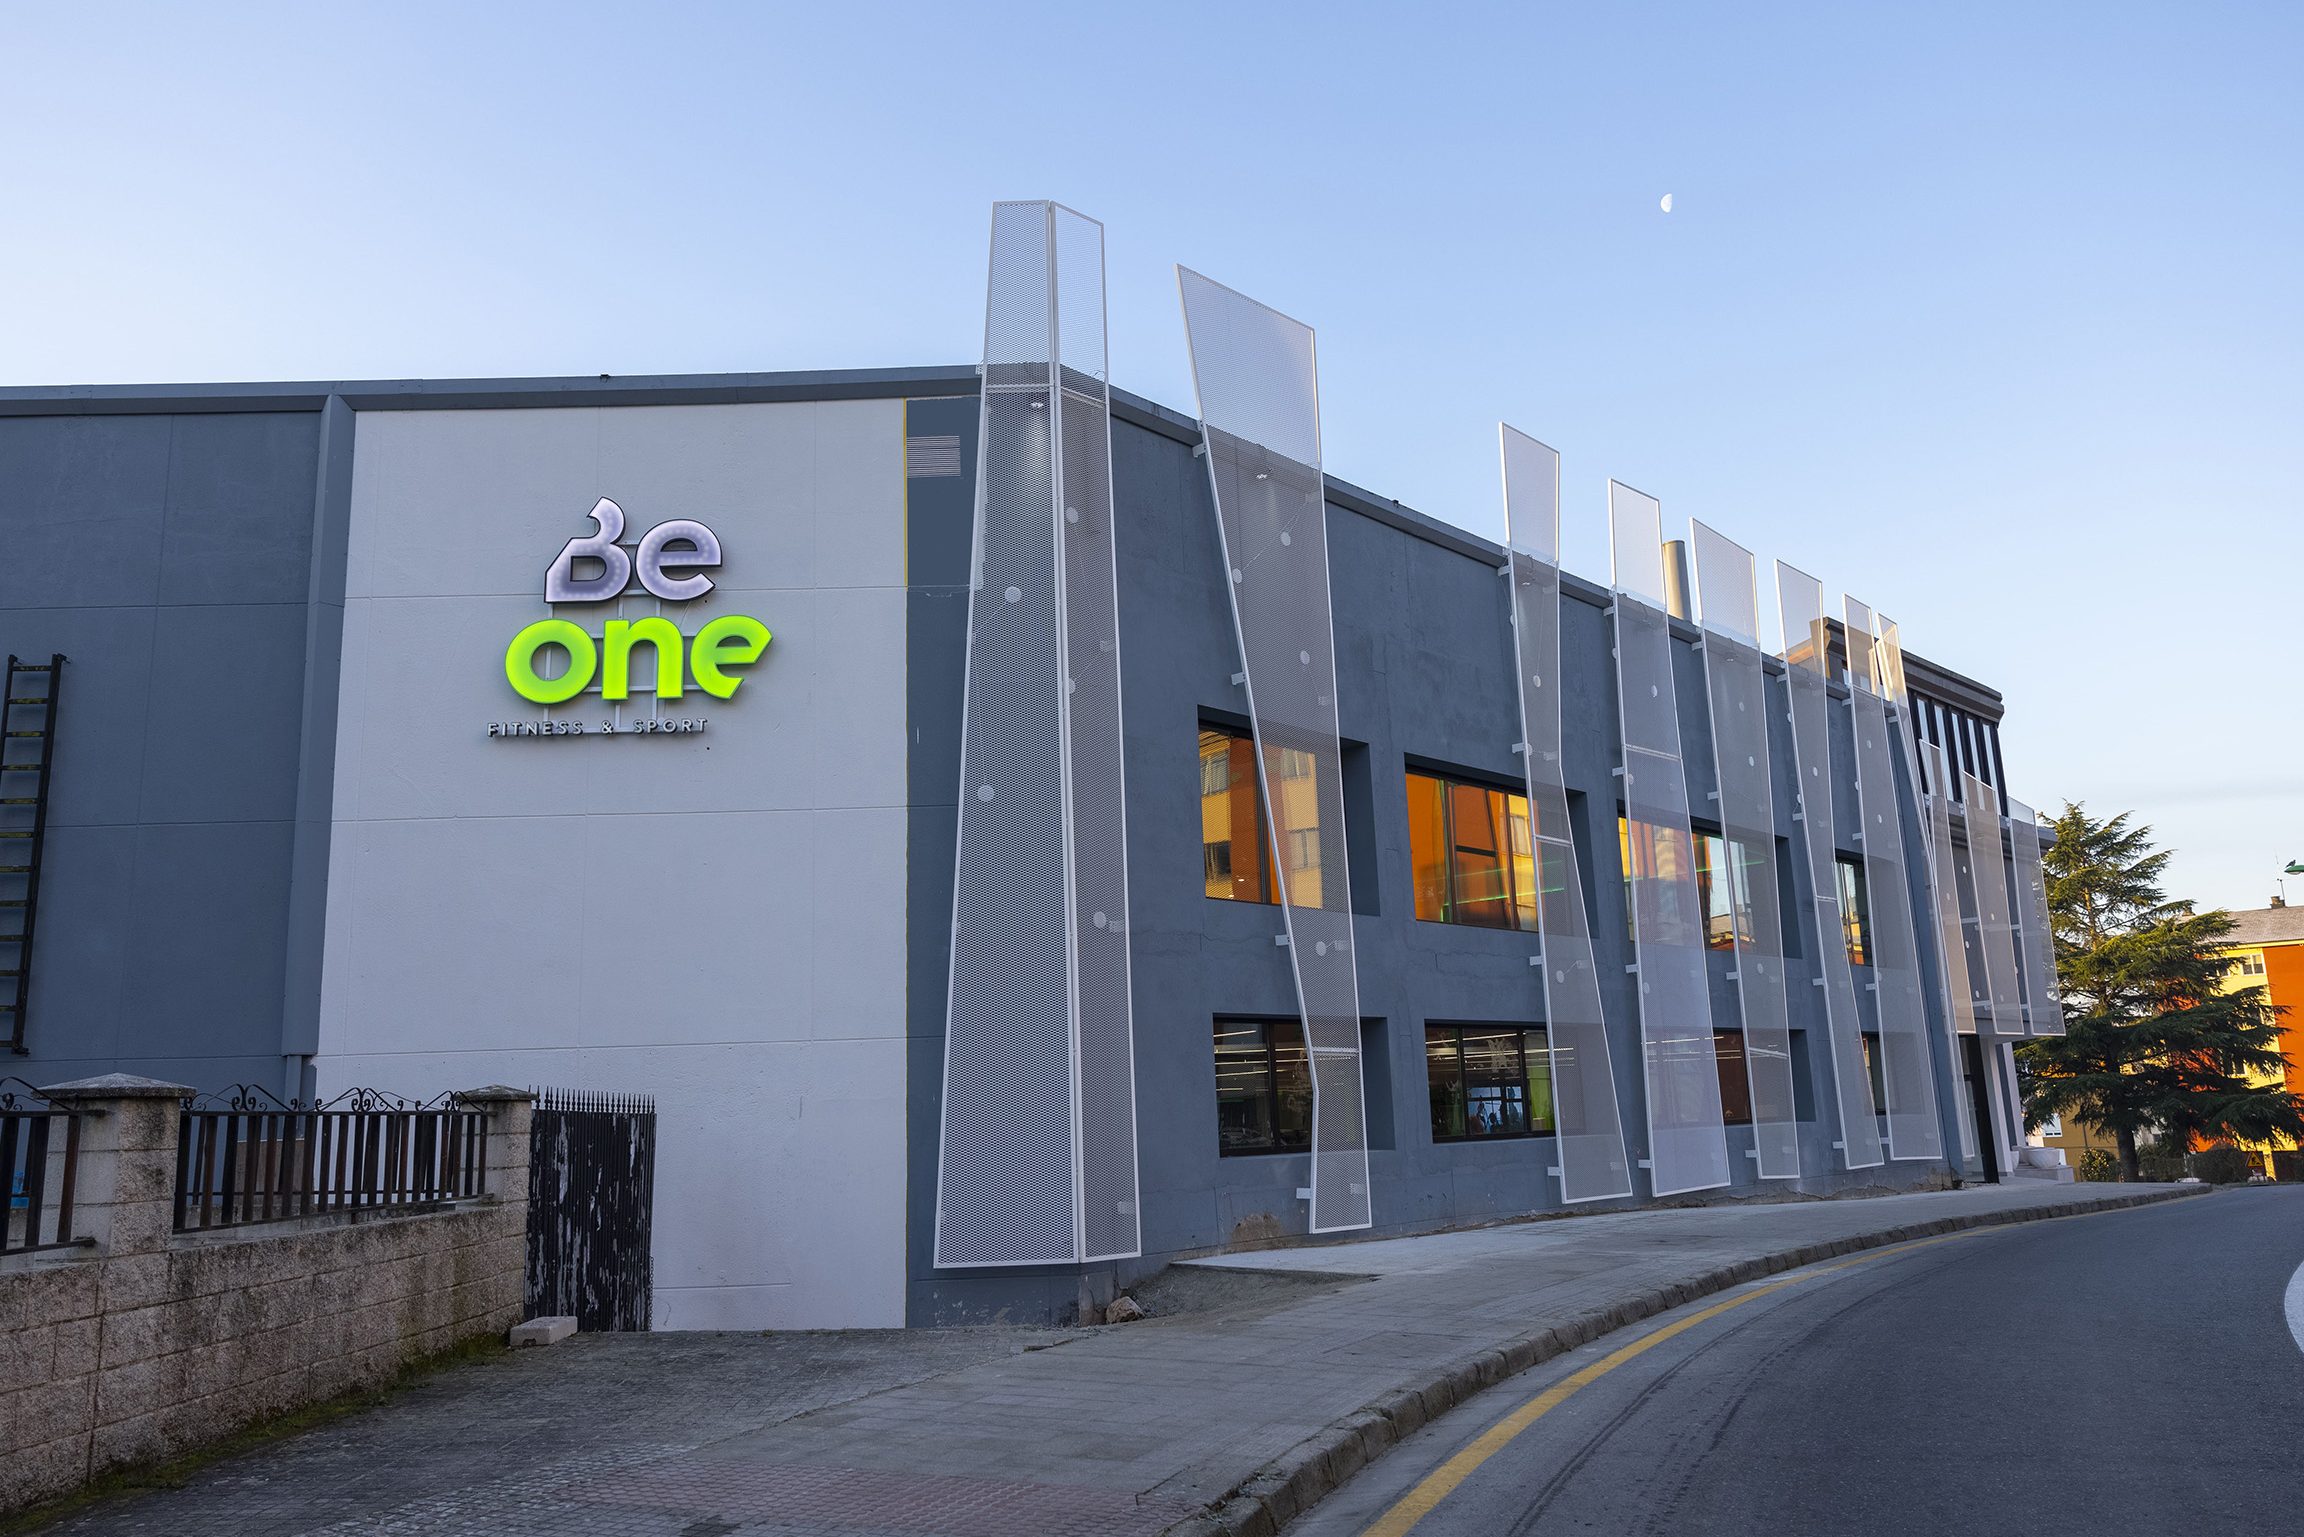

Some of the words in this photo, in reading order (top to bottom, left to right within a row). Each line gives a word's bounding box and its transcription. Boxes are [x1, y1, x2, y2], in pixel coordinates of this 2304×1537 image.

[544, 496, 722, 602] Be
[505, 615, 773, 704] one
[487, 720, 583, 737] FITNESS
[601, 720, 614, 734] &
[633, 718, 708, 734] SPORT
